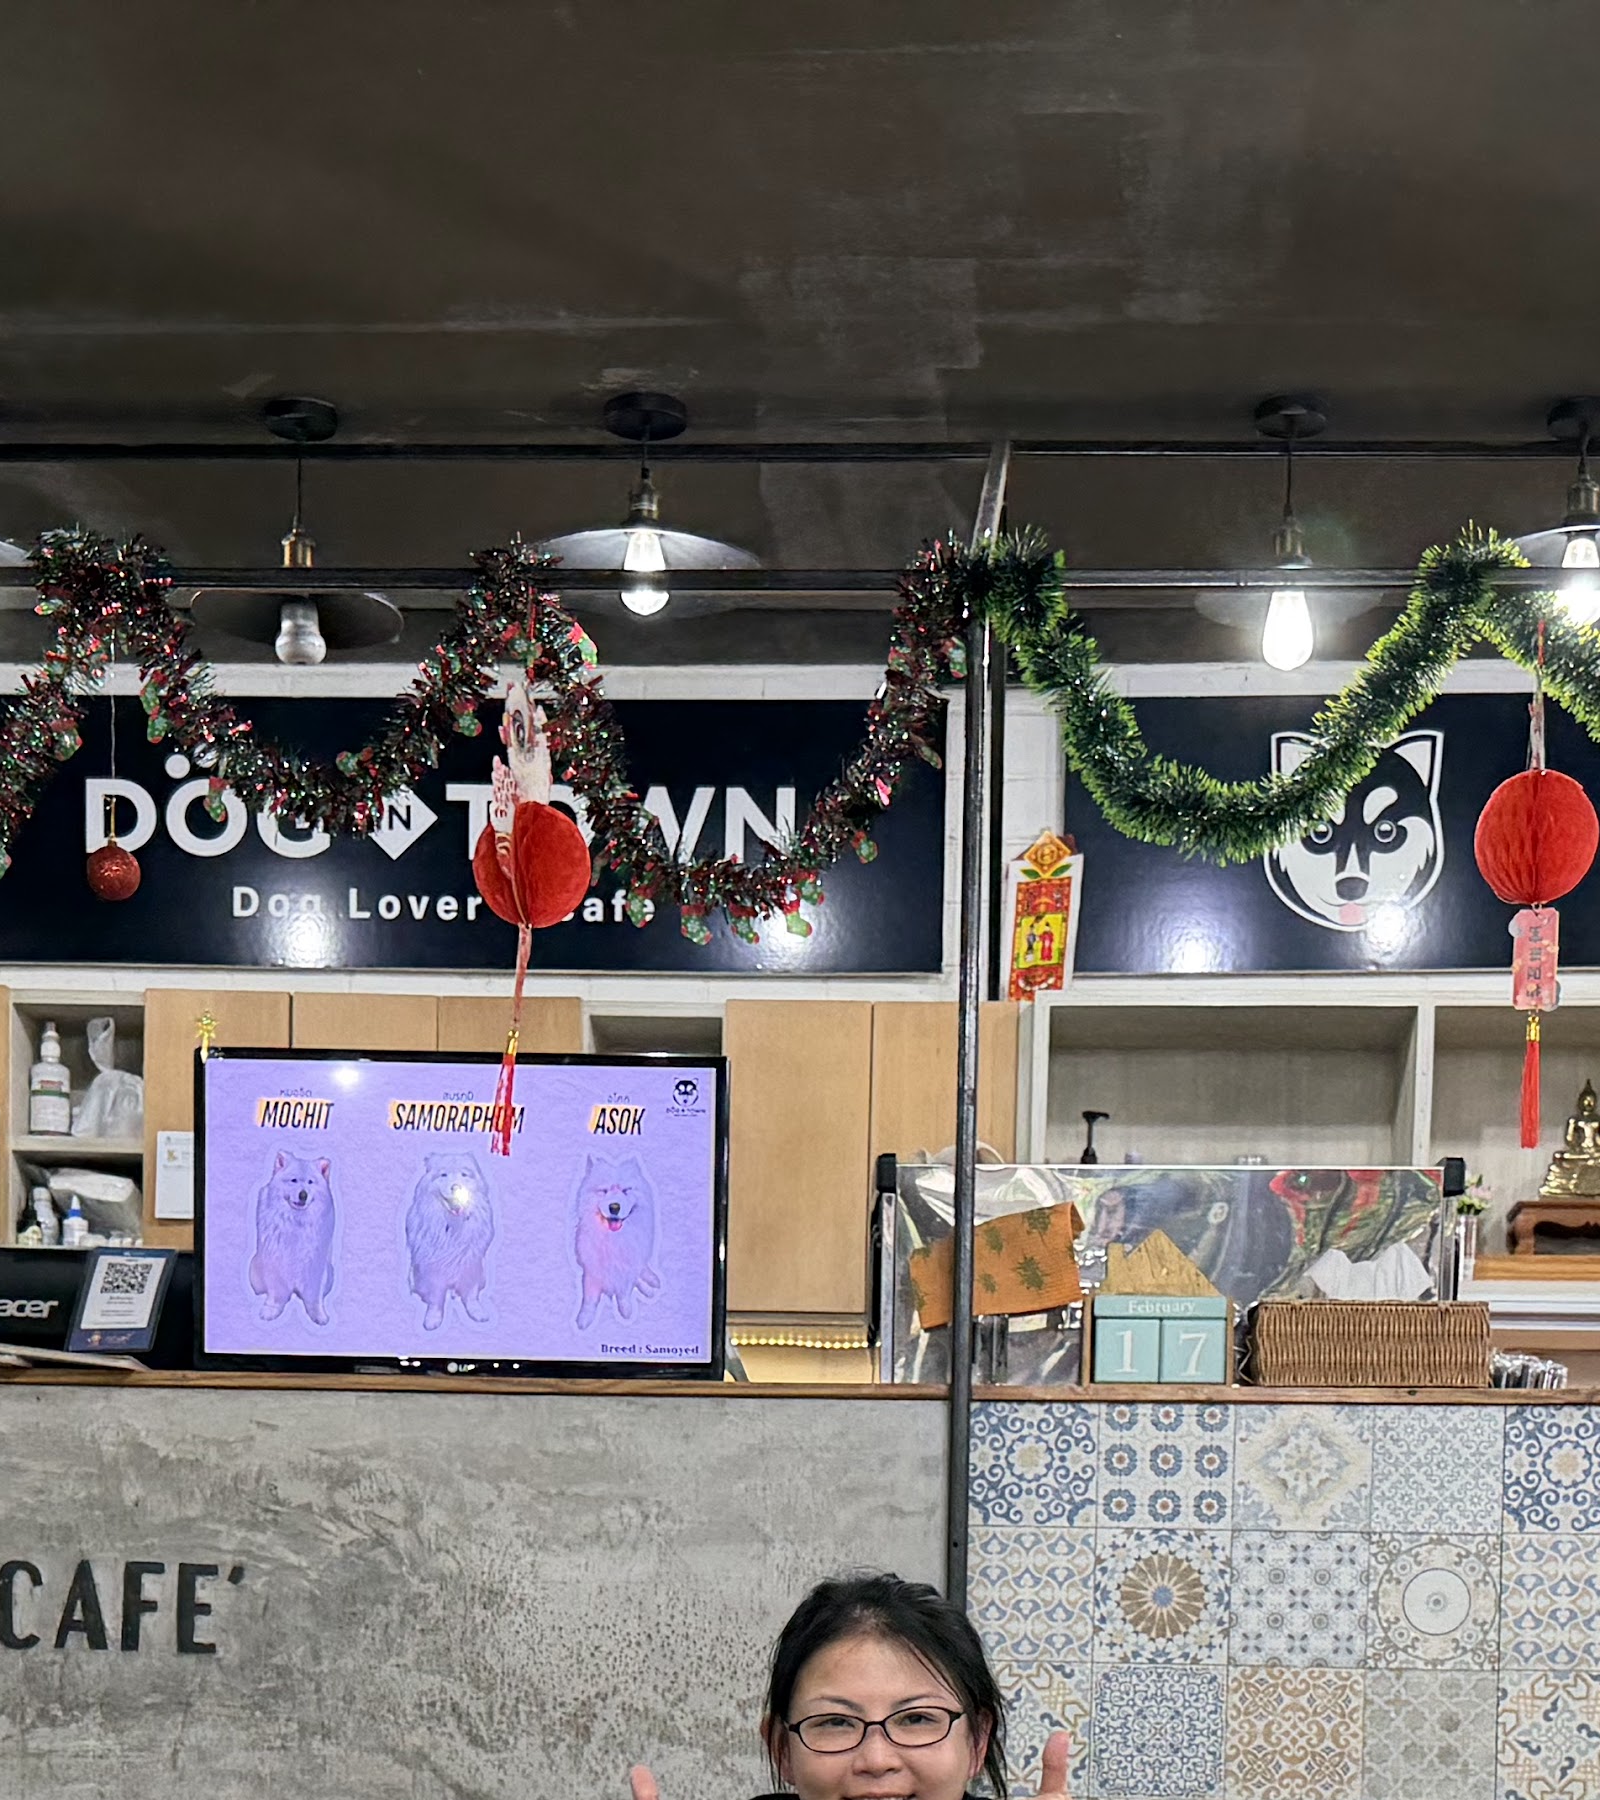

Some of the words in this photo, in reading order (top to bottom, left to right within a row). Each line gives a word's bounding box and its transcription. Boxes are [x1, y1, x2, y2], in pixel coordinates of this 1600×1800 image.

[562, 892, 657, 922] afe
[261, 1100, 335, 1129] MOCHIT
[593, 1107, 646, 1135] ASOK
[1128, 1299, 1196, 1315] February
[600, 1343, 637, 1354] Breed
[644, 1343, 699, 1357] Samoyed
